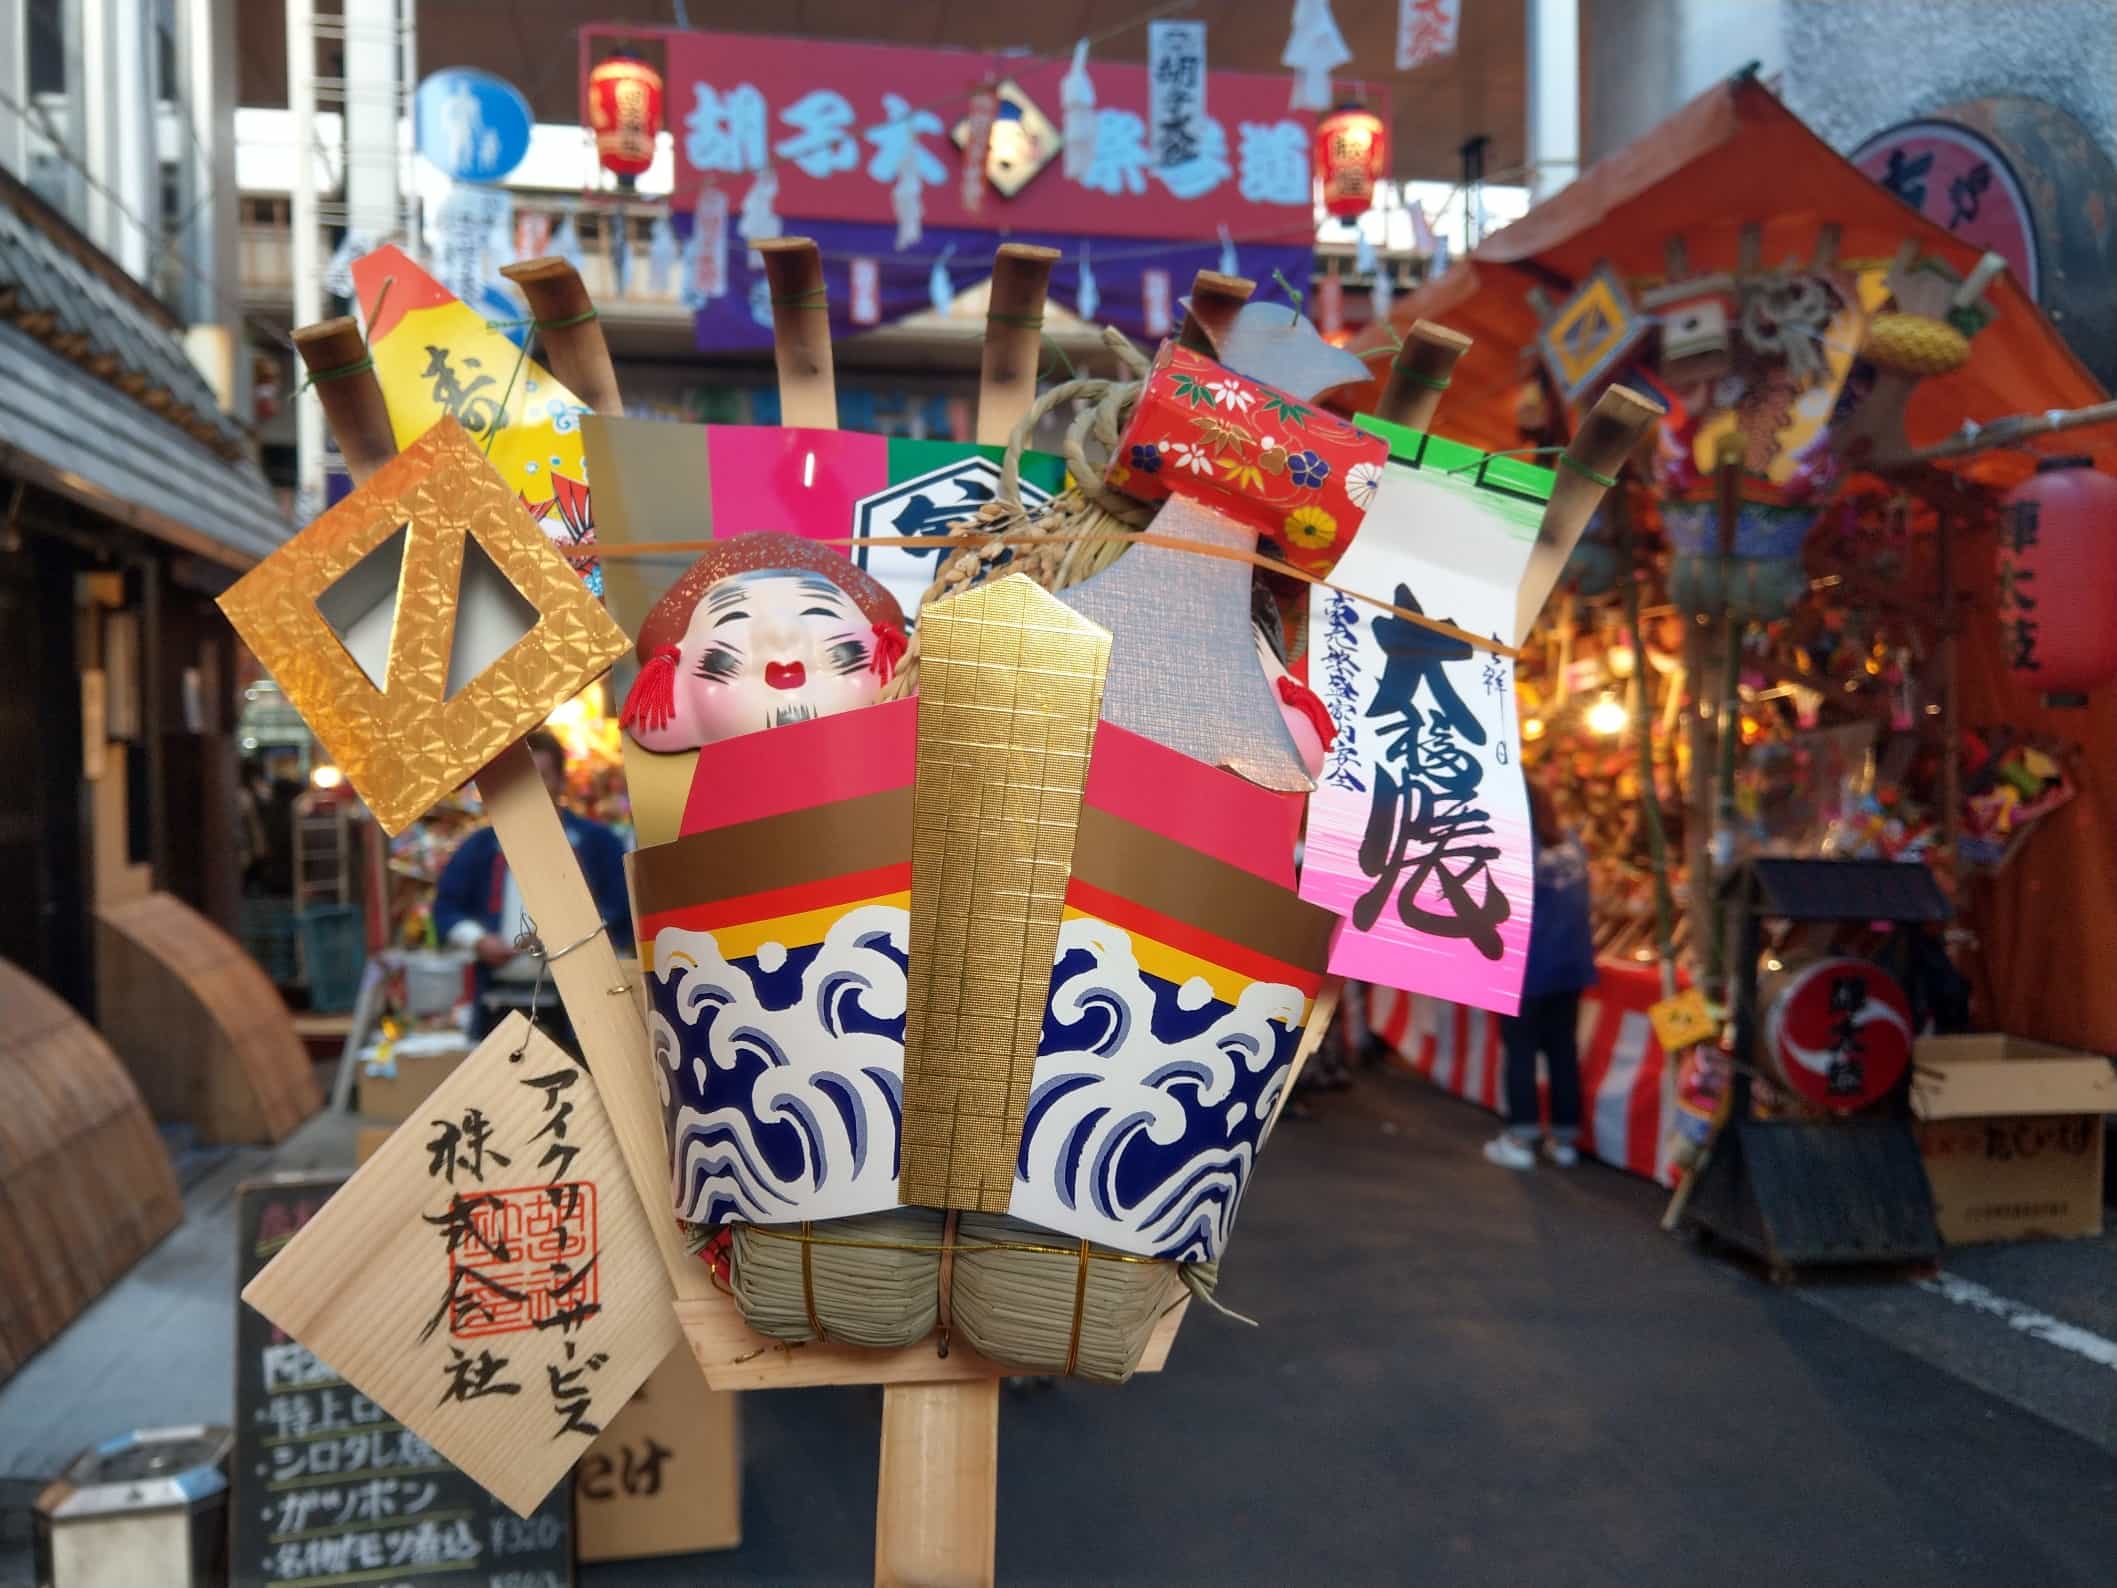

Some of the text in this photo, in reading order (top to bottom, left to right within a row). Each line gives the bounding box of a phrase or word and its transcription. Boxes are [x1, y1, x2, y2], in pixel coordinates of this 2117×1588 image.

[416, 1108, 529, 1410] 株式会社
[519, 1068, 609, 1440] アイクリーンサービス
